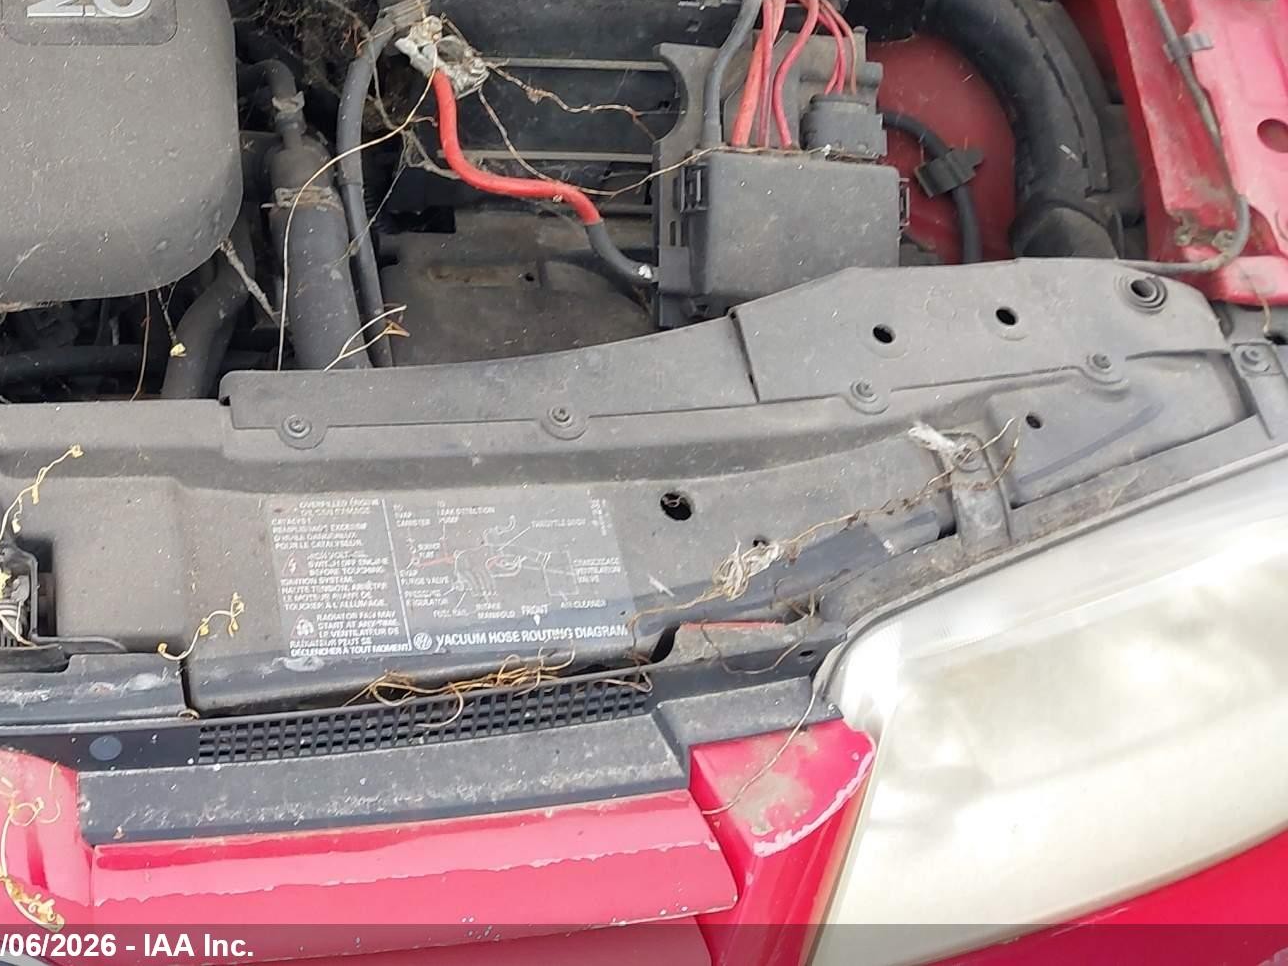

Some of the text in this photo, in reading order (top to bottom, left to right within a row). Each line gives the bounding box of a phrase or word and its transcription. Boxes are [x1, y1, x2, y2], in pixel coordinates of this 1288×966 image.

[436, 631, 487, 647] VACUUM
[488, 630, 521, 644] HOSE
[521, 628, 574, 642] ROUTING
[574, 624, 628, 639] DIAGRAM
